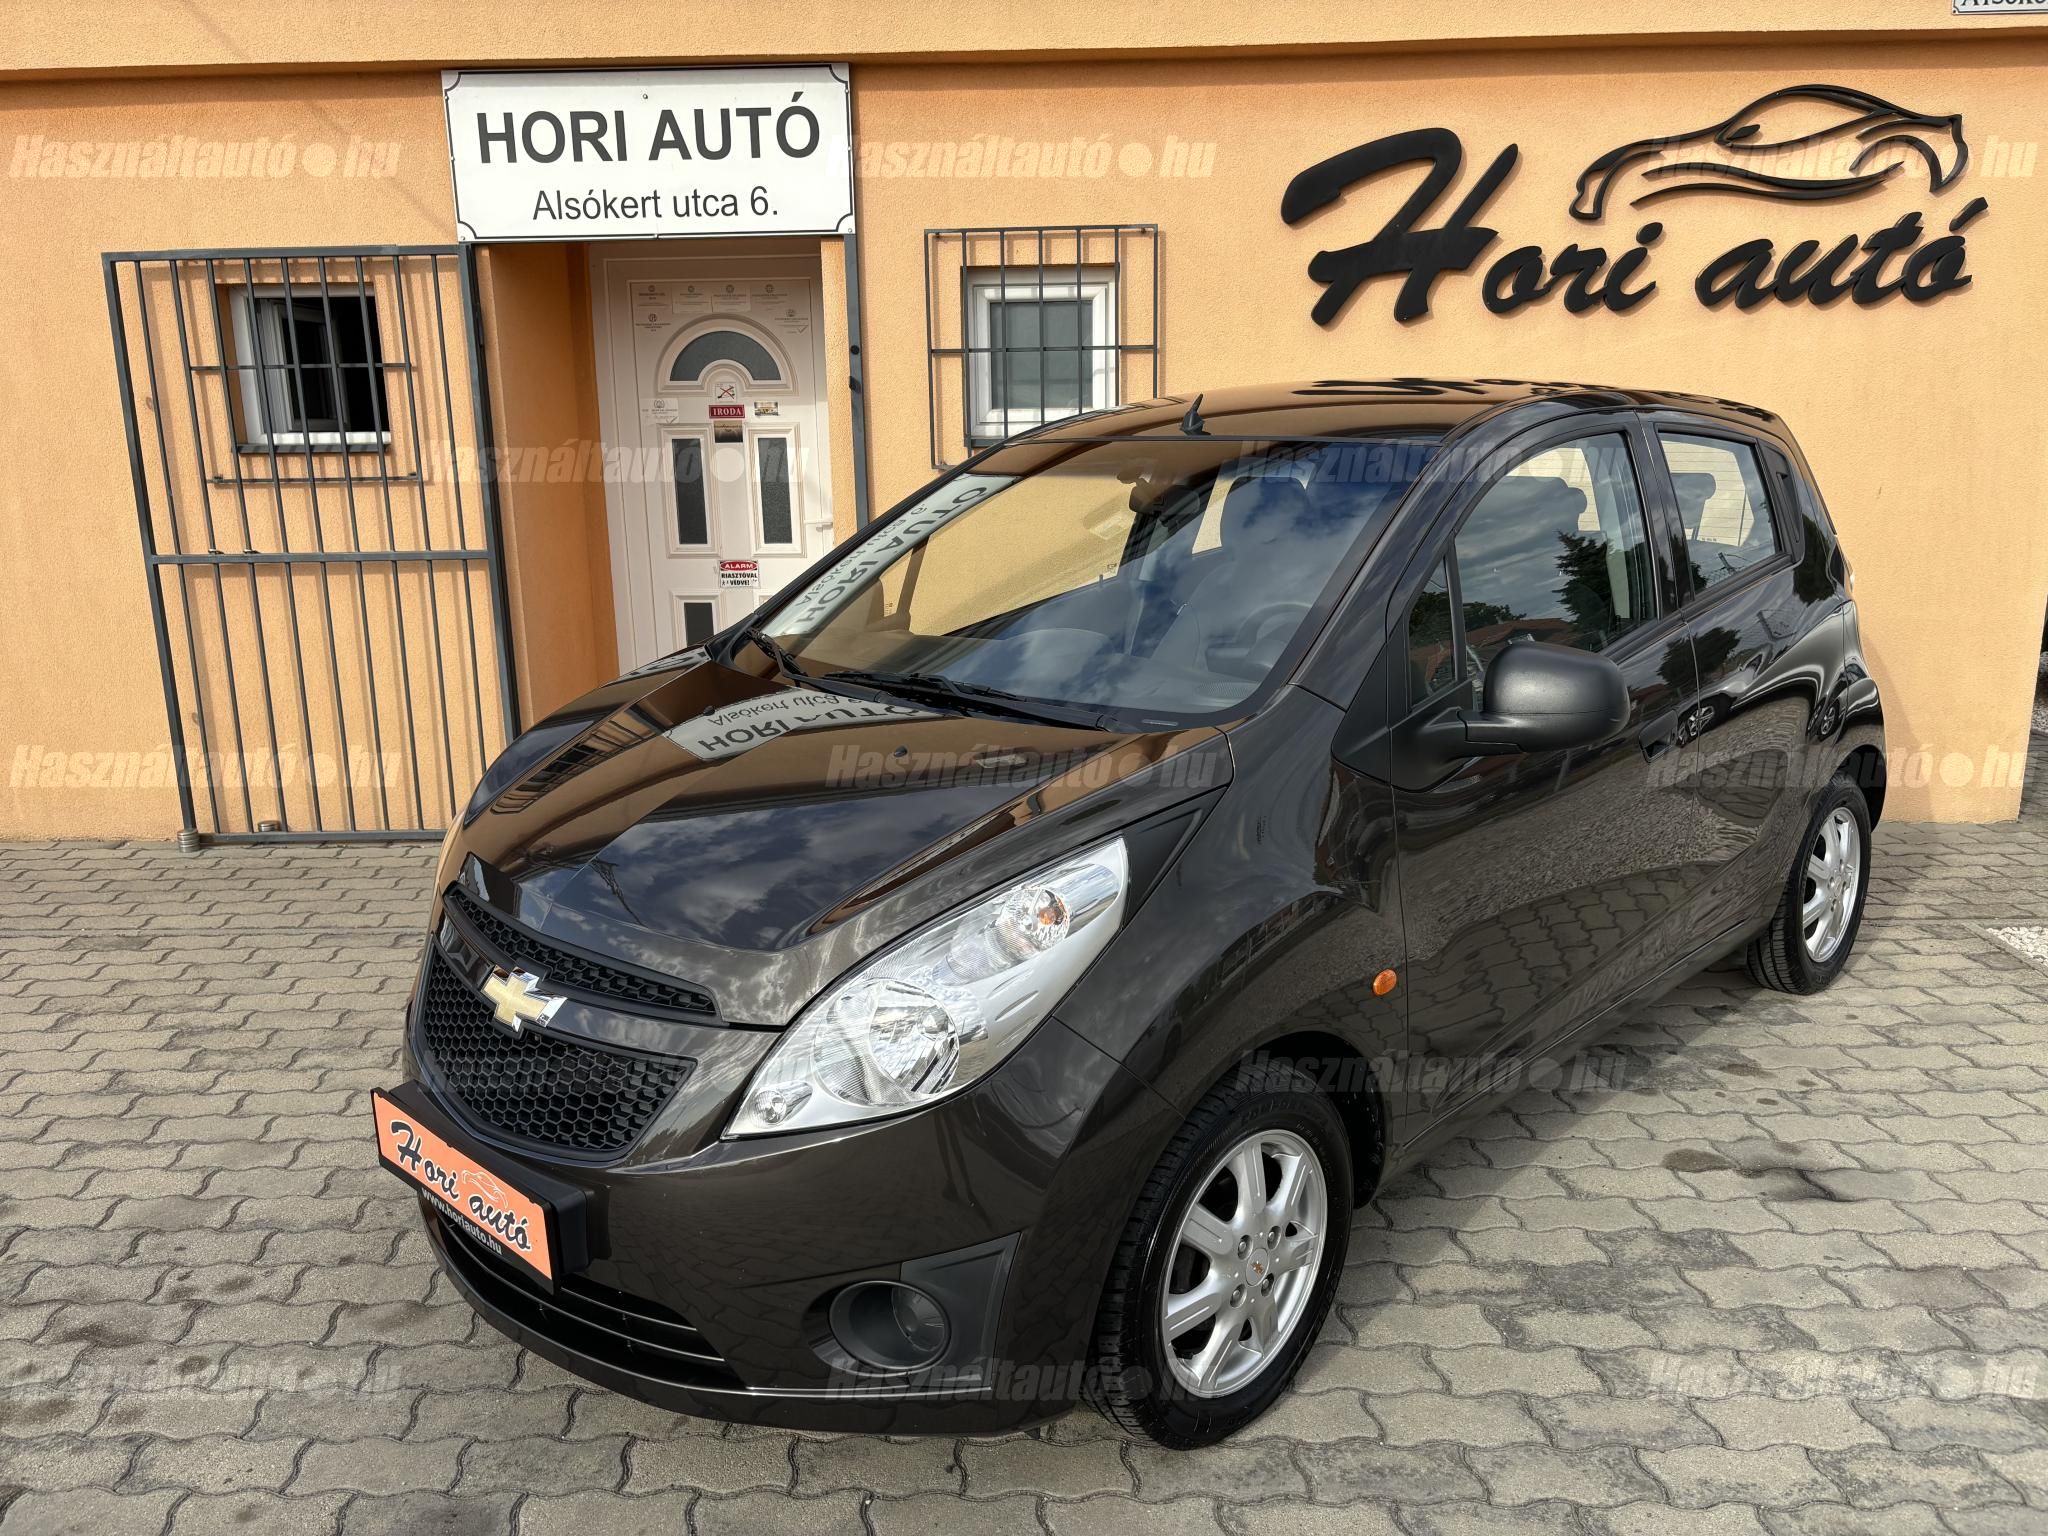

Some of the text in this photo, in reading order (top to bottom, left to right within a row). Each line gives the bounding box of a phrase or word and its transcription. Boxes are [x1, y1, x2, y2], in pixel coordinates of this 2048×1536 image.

[477, 92, 820, 163] HORI AUTÓ
[533, 186, 778, 220] Alsókert utca 6.
[1281, 127, 1988, 327] Hori autó
[713, 408, 742, 417] IRODA
[391, 1120, 531, 1250] Hori autó
[421, 1187, 502, 1255] www.horiauto.hu
